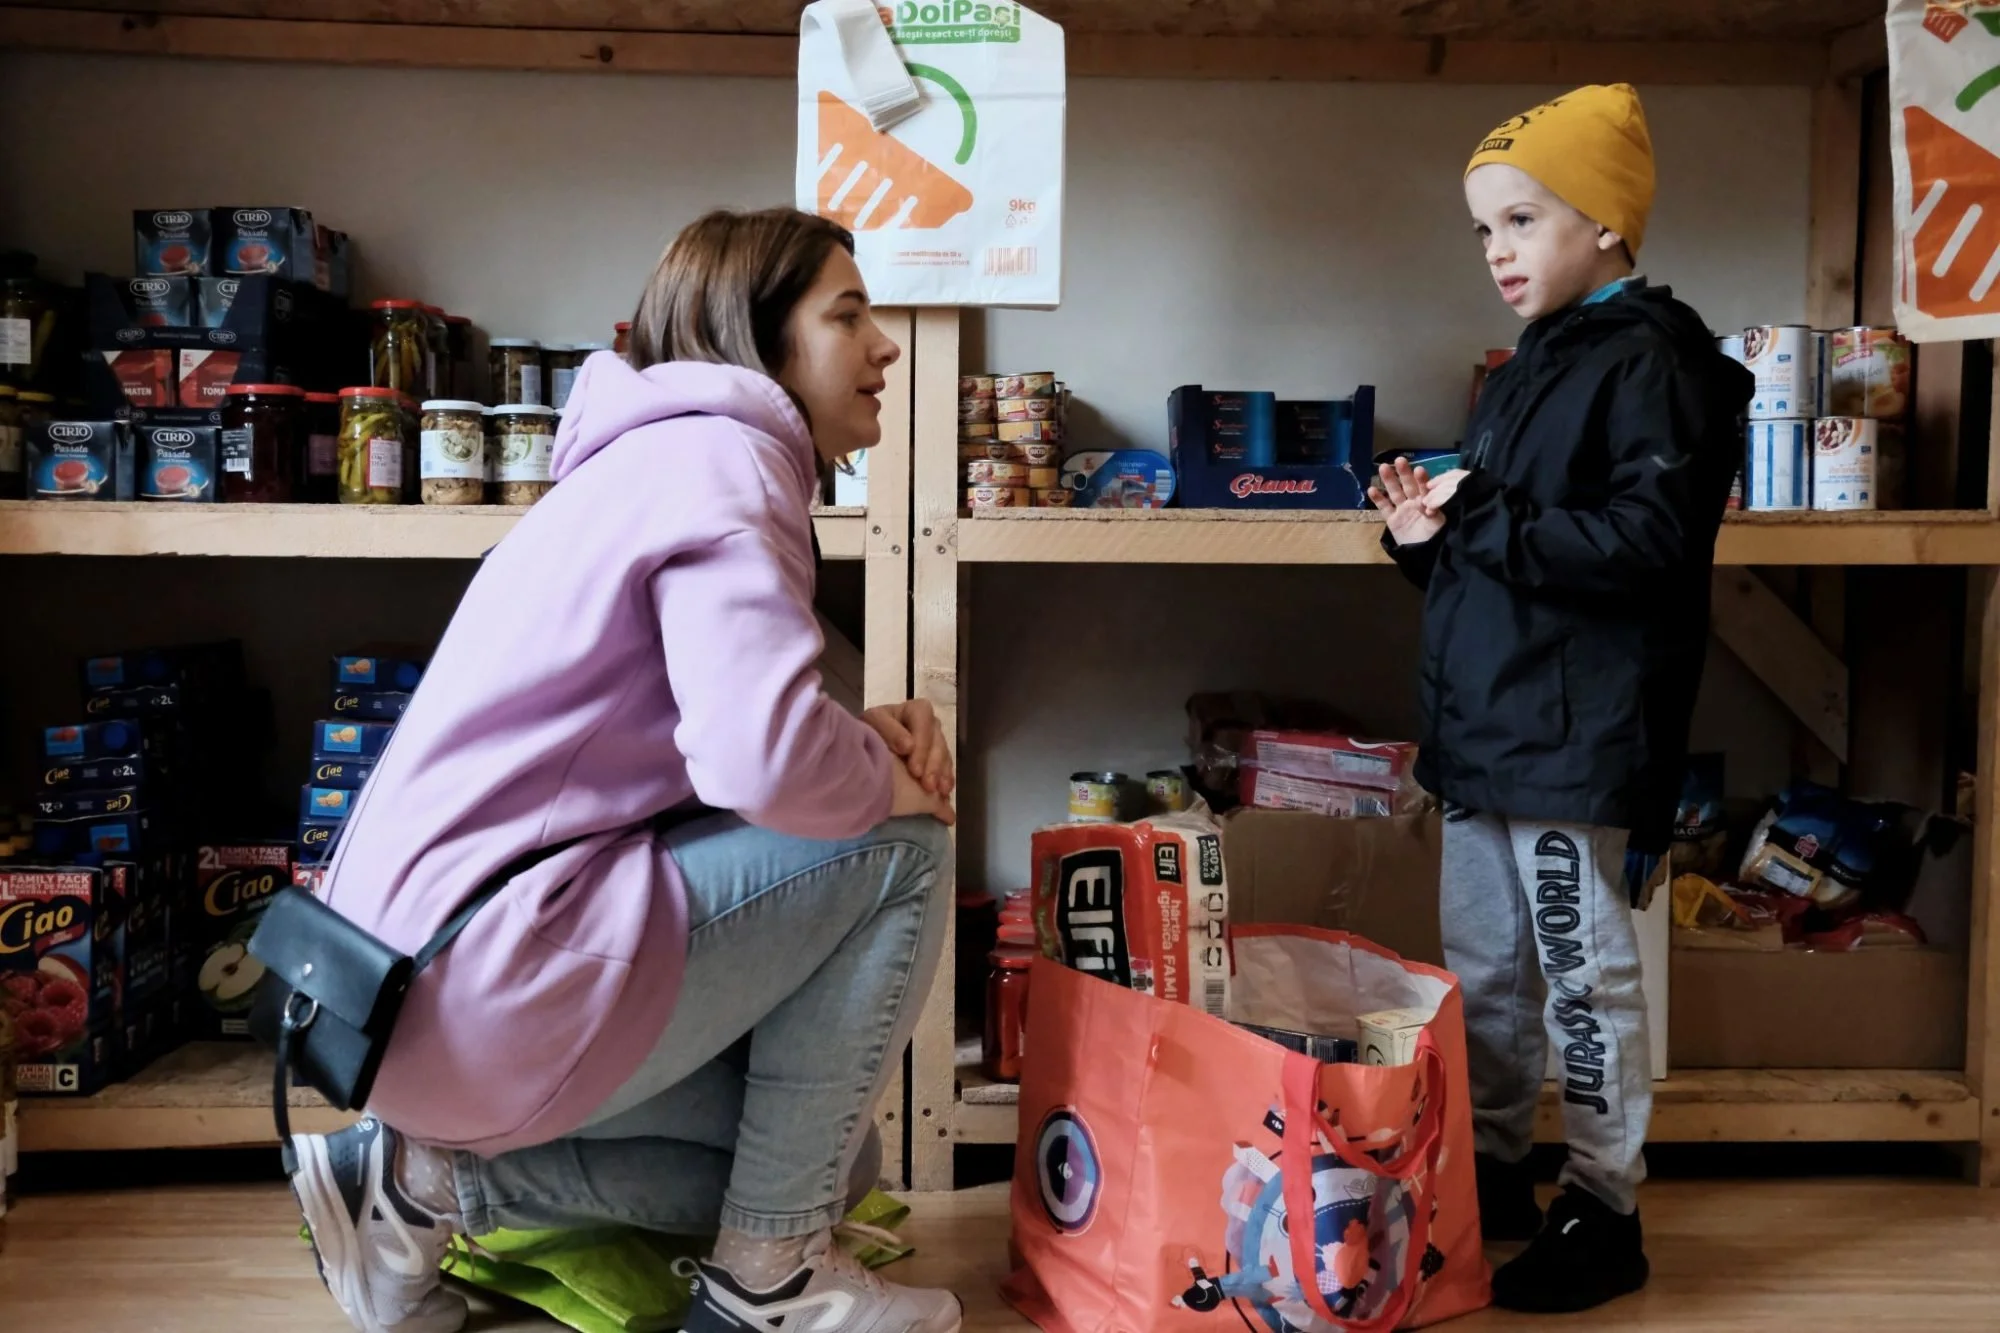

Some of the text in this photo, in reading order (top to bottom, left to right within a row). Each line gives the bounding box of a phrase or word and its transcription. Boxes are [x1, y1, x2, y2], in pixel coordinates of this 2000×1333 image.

[157, 215, 189, 224] CIRIO
[237, 213, 267, 223] CIRIO
[133, 282, 166, 292] CIRIO
[122, 387, 152, 396] MATEN
[202, 387, 226, 396] TOMA
[53, 427, 88, 437] CIRIO
[156, 432, 190, 442] CIRIO
[1230, 473, 1318, 499] Giana
[334, 696, 359, 711] Ciao
[316, 764, 342, 780] Ciao
[303, 828, 329, 844] Ciao
[198, 845, 227, 870] 2L
[259, 847, 287, 855] PACK
[10, 875, 90, 884] FAMILY PACK
[204, 870, 273, 917] Ciao
[1535, 830, 1587, 974] WORLD
[0, 902, 74, 954] Ciao
[1163, 954, 1178, 999] FAMI
[59, 1068, 74, 1087] C
